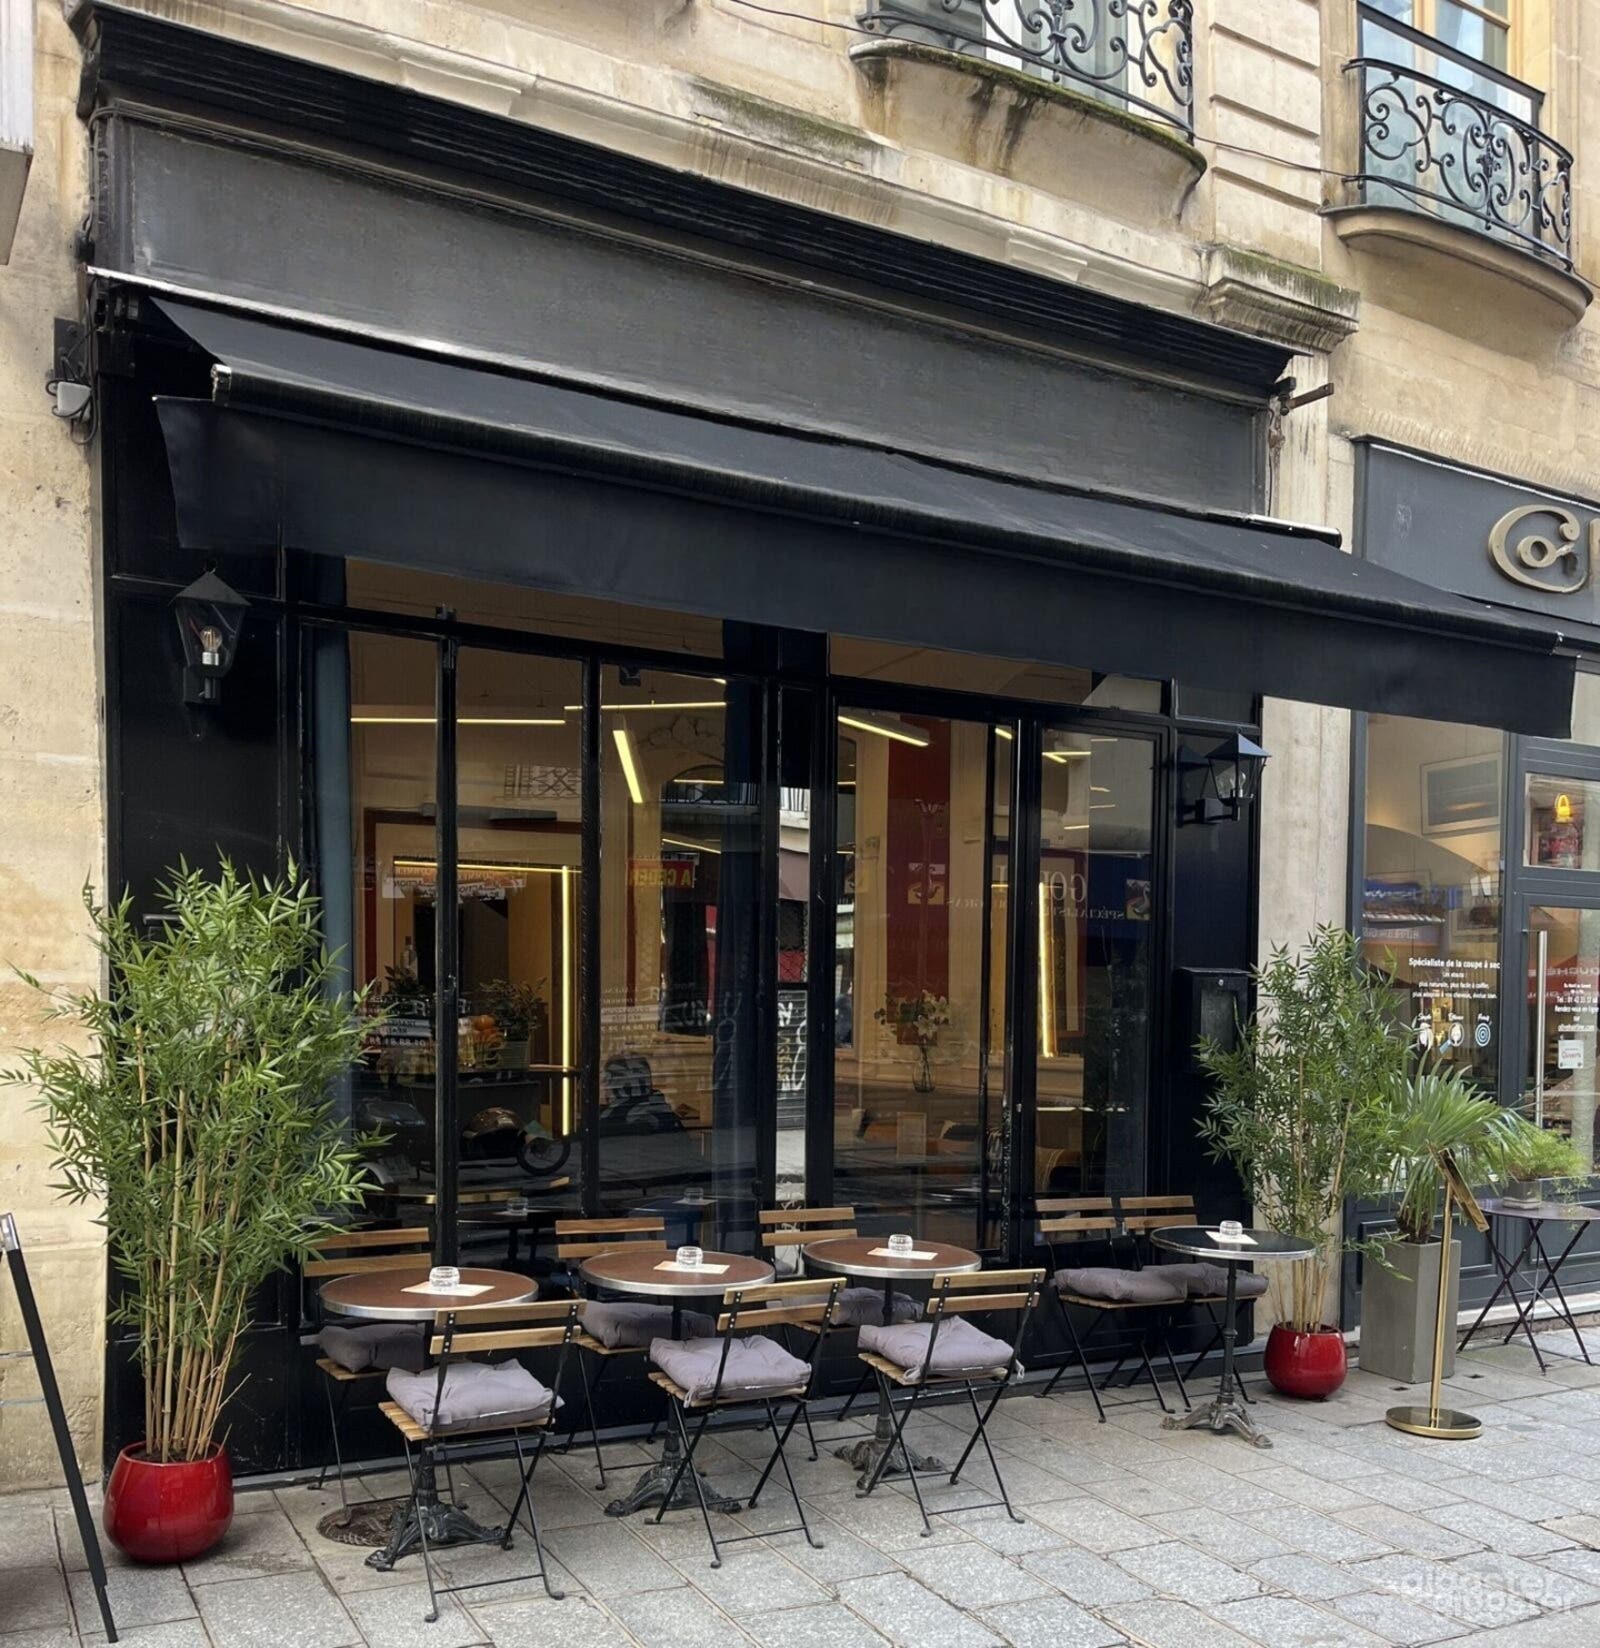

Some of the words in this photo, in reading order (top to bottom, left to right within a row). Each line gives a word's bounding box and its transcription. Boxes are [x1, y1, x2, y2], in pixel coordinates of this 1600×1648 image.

[1408, 957, 1445, 968] Spécialiste
[1446, 959, 1454, 967] de
[1455, 959, 1462, 967] la
[1463, 961, 1482, 969] coupe
